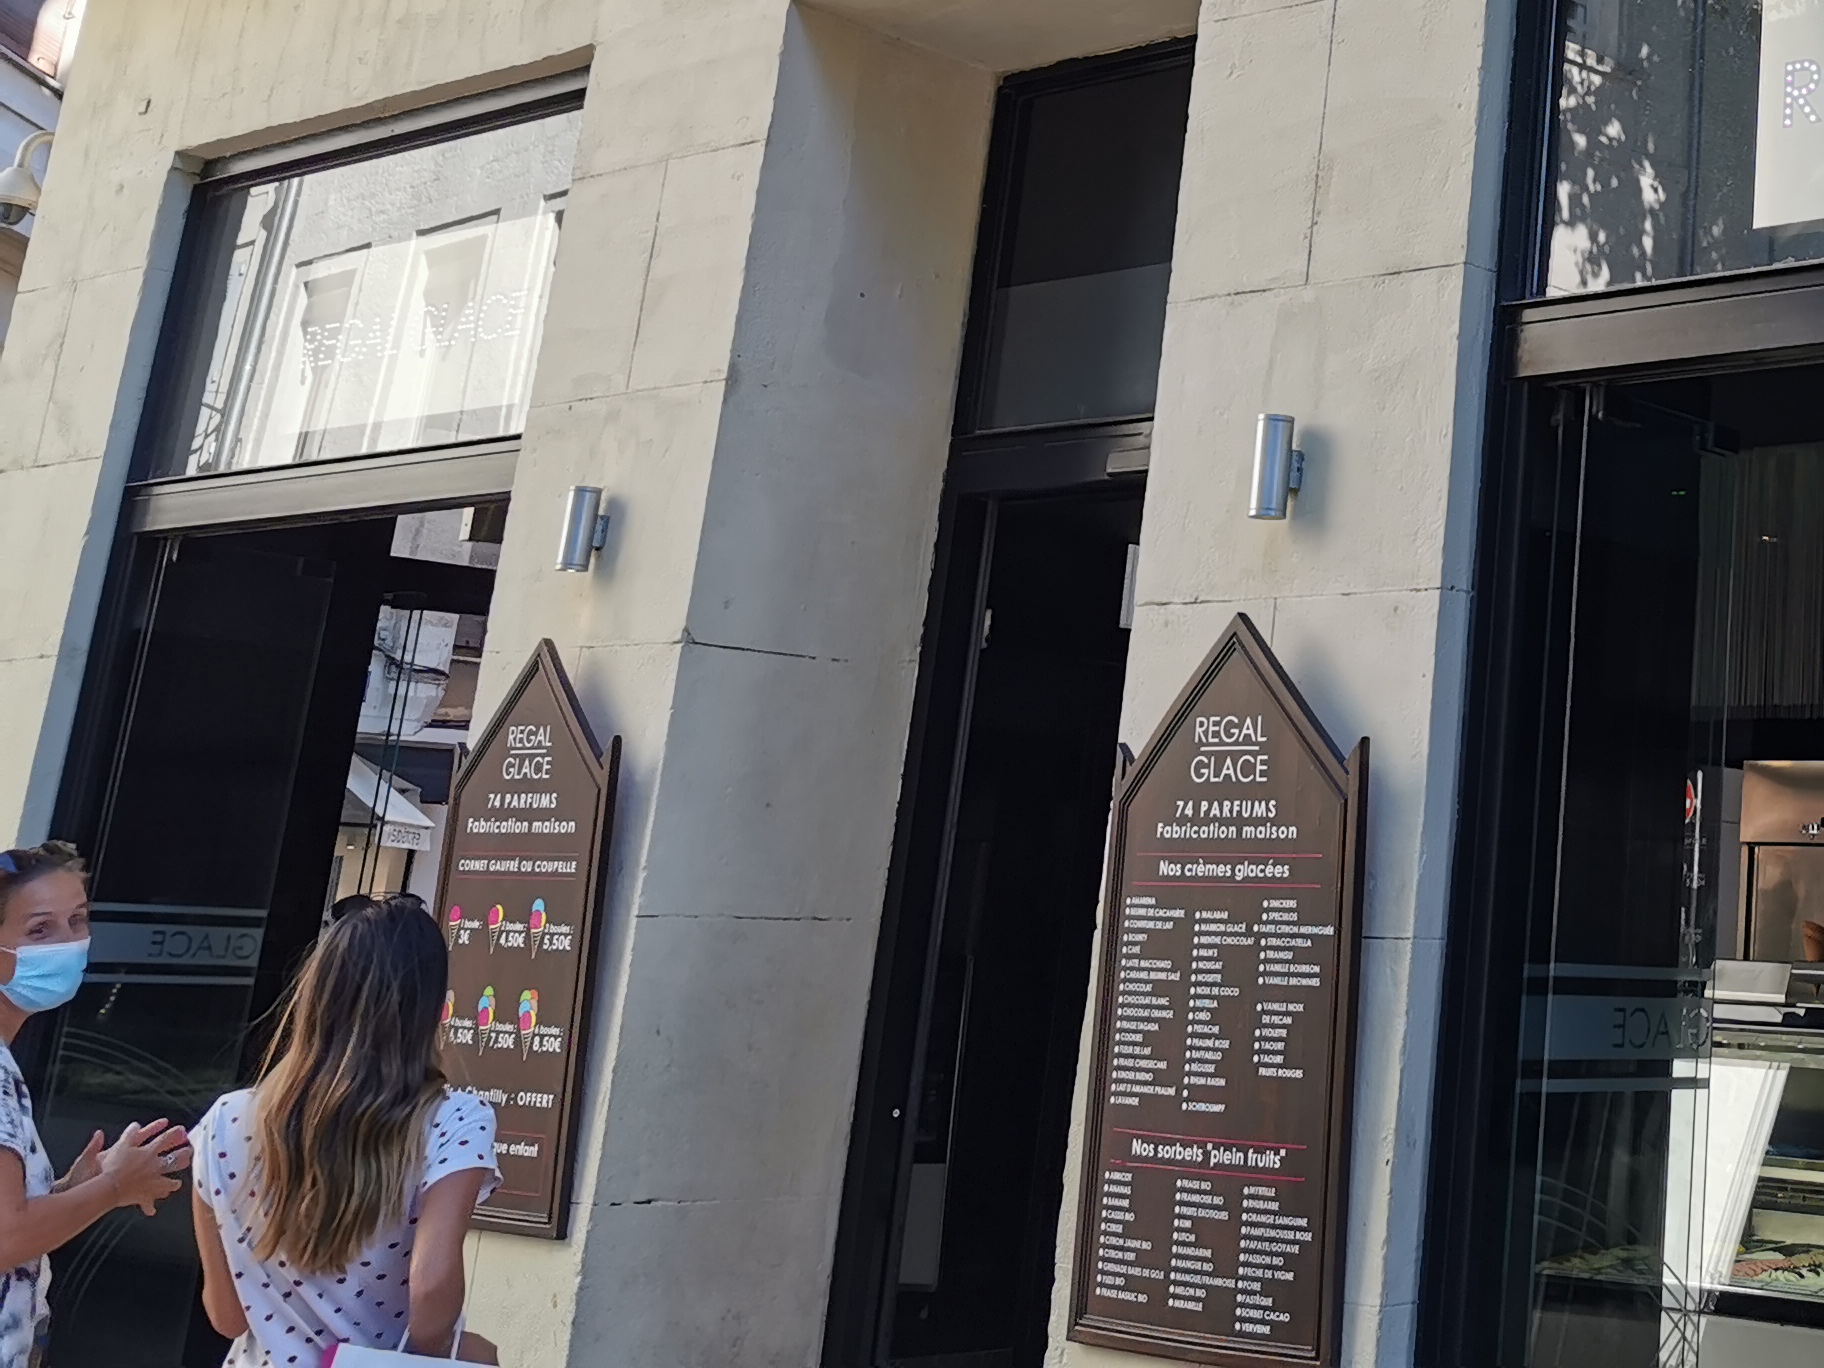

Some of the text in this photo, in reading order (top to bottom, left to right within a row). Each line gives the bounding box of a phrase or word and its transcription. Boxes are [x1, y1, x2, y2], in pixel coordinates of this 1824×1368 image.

[507, 725, 552, 748] REGAL
[1195, 715, 1268, 744] REGAL
[503, 757, 552, 779] GLACE
[1190, 755, 1268, 783] GLACE
[488, 792, 558, 809] 74 PARFUMS
[1175, 800, 1277, 818] 74 PARFUMS
[467, 817, 575, 833] Fabrication maison
[1156, 822, 1297, 839] Fabrication maison
[459, 857, 577, 872] CORNET GAUFRÉ OU COUPELLE
[1159, 858, 1290, 880] Nos crèmes glacées
[458, 930, 469, 944] 3€
[500, 934, 525, 948] 4,50€
[543, 935, 571, 950] 5,50€
[1222, 936, 1254, 945] CHOCOLAT
[1198, 961, 1222, 969] NOUGAT
[1266, 963, 1320, 973] VANILLE BOURBON
[1125, 983, 1153, 992] CHOCOLAT
[1196, 986, 1211, 994] NOIX
[1220, 987, 1239, 996] COCO
[1124, 995, 1151, 1004] CHOCOLAT
[1123, 1007, 1150, 1016] CHOCOLAT
[1271, 1015, 1292, 1024] PECAN
[489, 1034, 516, 1048] 7,50€
[532, 1038, 562, 1053] 8,50€
[1261, 1041, 1285, 1050] YAOURT
[1260, 1054, 1284, 1063] YAOURT
[1278, 1068, 1303, 1078] ROUGES
[517, 1092, 554, 1108] OFFERT
[509, 1140, 538, 1157] enfant
[1131, 1138, 1286, 1169] Nos sorbets "plein fruits"
[1296, 1232, 1312, 1241] ROSE
[1244, 1253, 1271, 1264] PASSION
[1243, 1281, 1261, 1291] POIRE
[1264, 1311, 1290, 1322] CACAO
